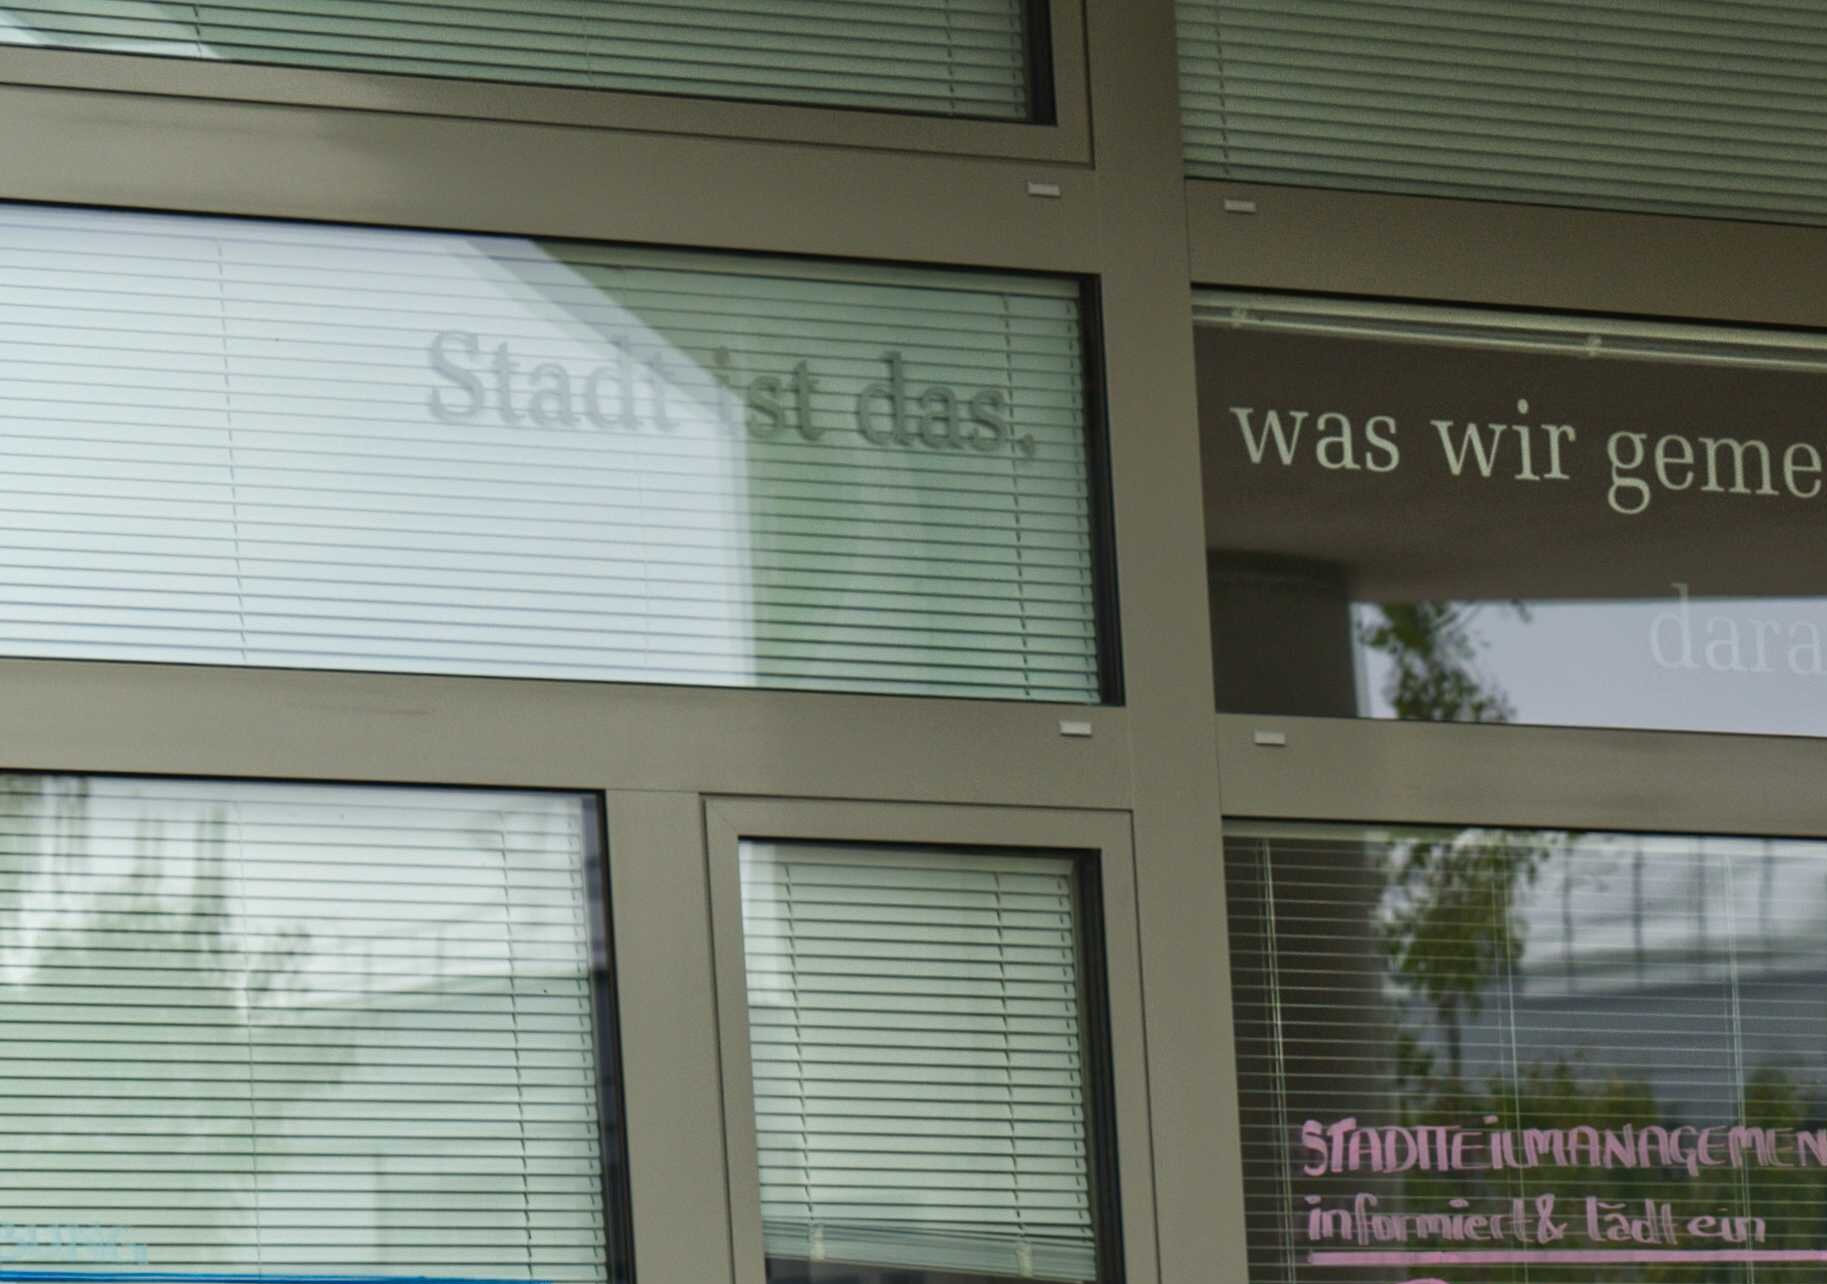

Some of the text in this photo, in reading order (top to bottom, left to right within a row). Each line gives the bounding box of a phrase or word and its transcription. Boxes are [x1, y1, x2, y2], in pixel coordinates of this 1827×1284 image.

[427, 330, 682, 436] Stadt
[711, 347, 826, 446] ist
[1229, 403, 1401, 474] was
[1430, 398, 1577, 485] wir
